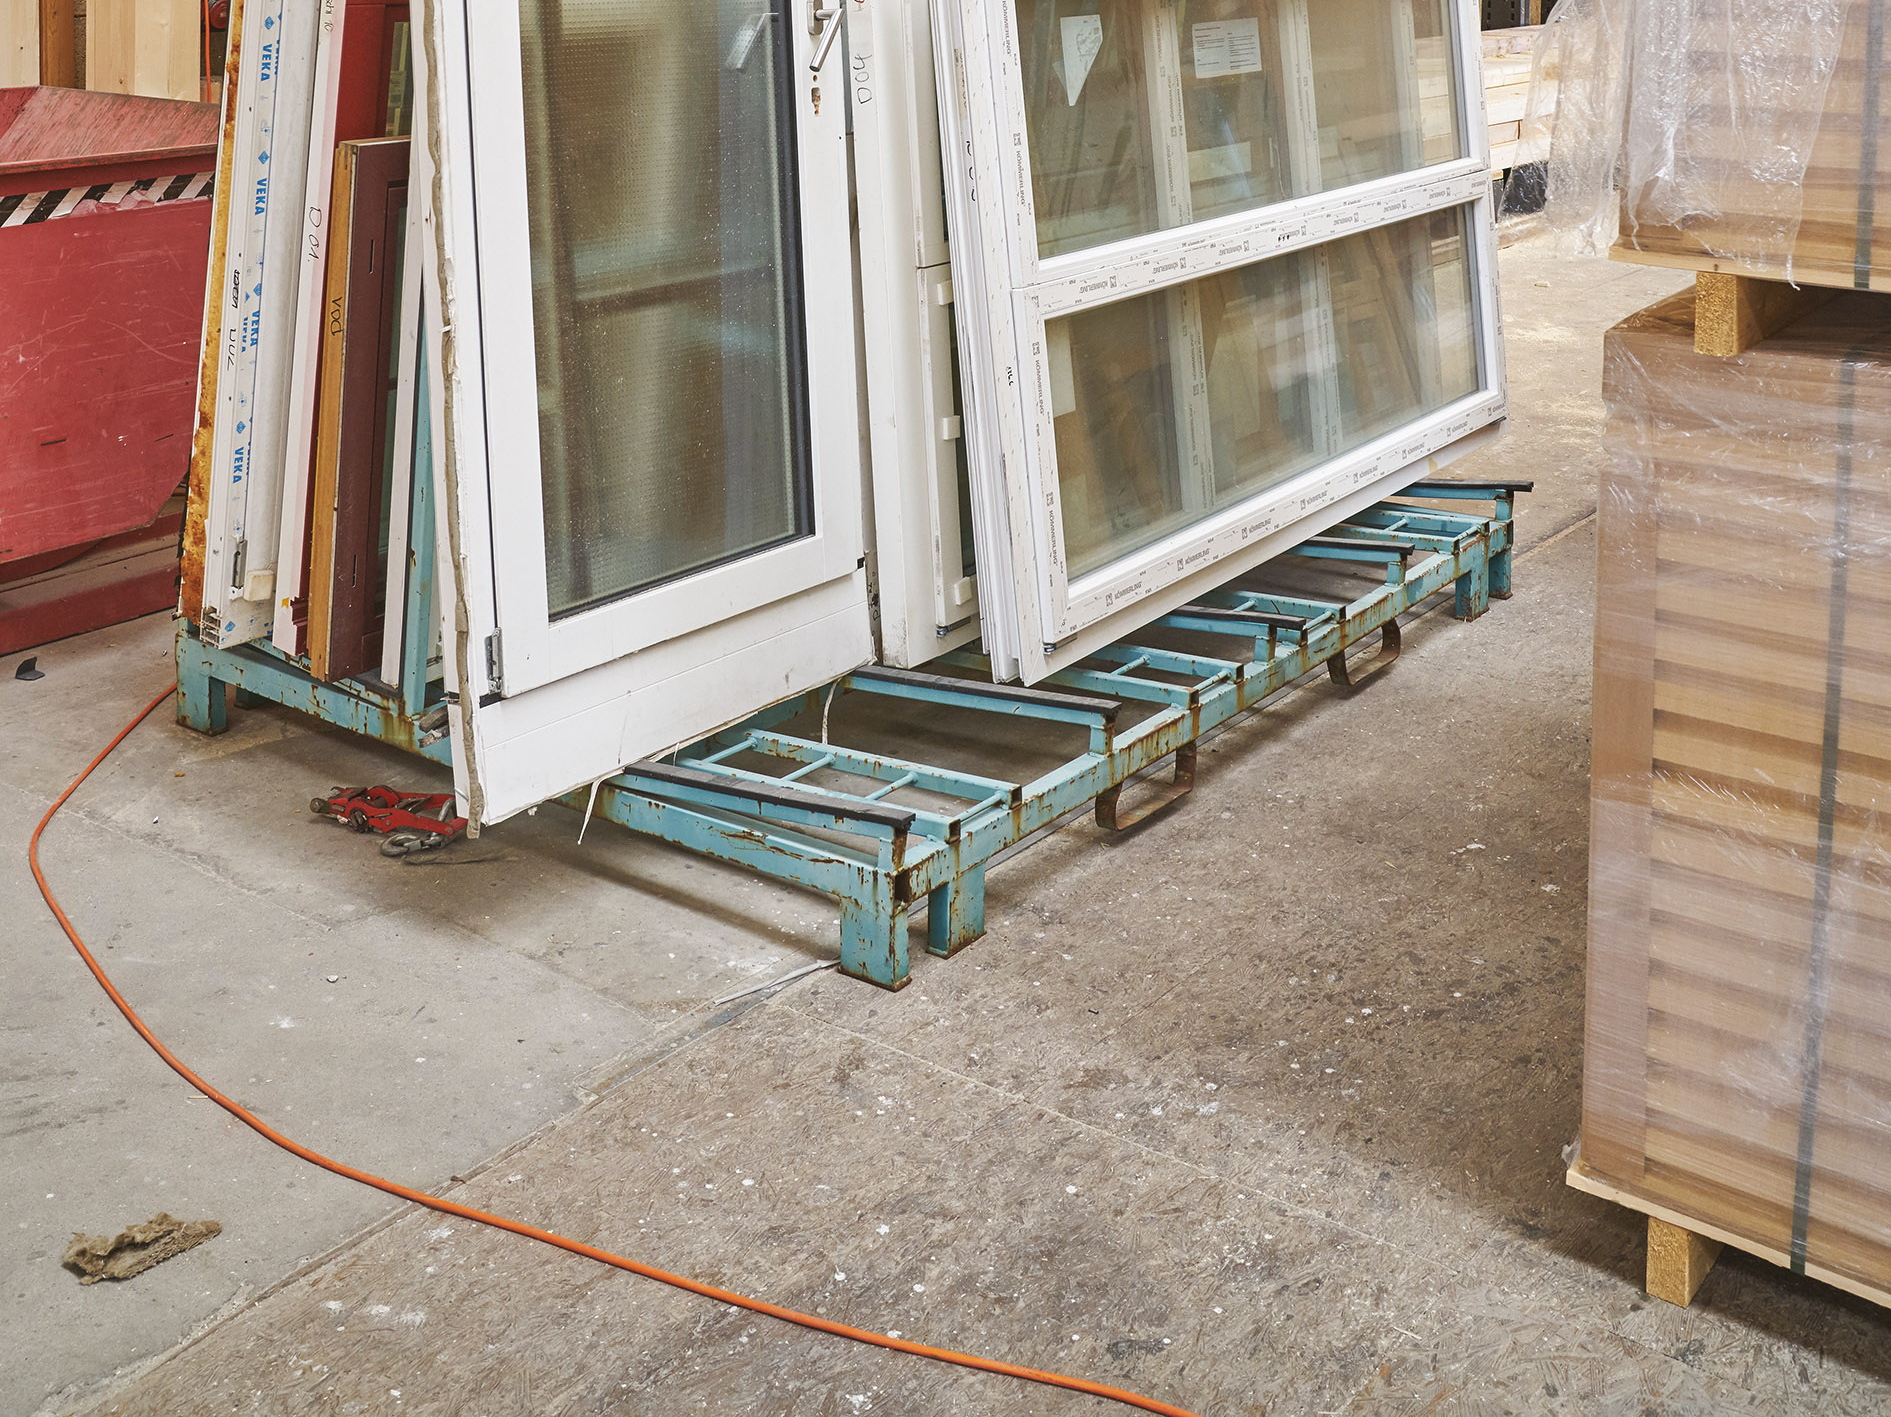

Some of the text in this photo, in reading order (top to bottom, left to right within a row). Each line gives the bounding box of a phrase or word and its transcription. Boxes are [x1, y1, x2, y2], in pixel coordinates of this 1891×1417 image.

[261, 44, 272, 81] VEKA
[255, 178, 267, 215] VEKA
[250, 310, 260, 347] VEKA
[232, 447, 244, 484] VEKA
